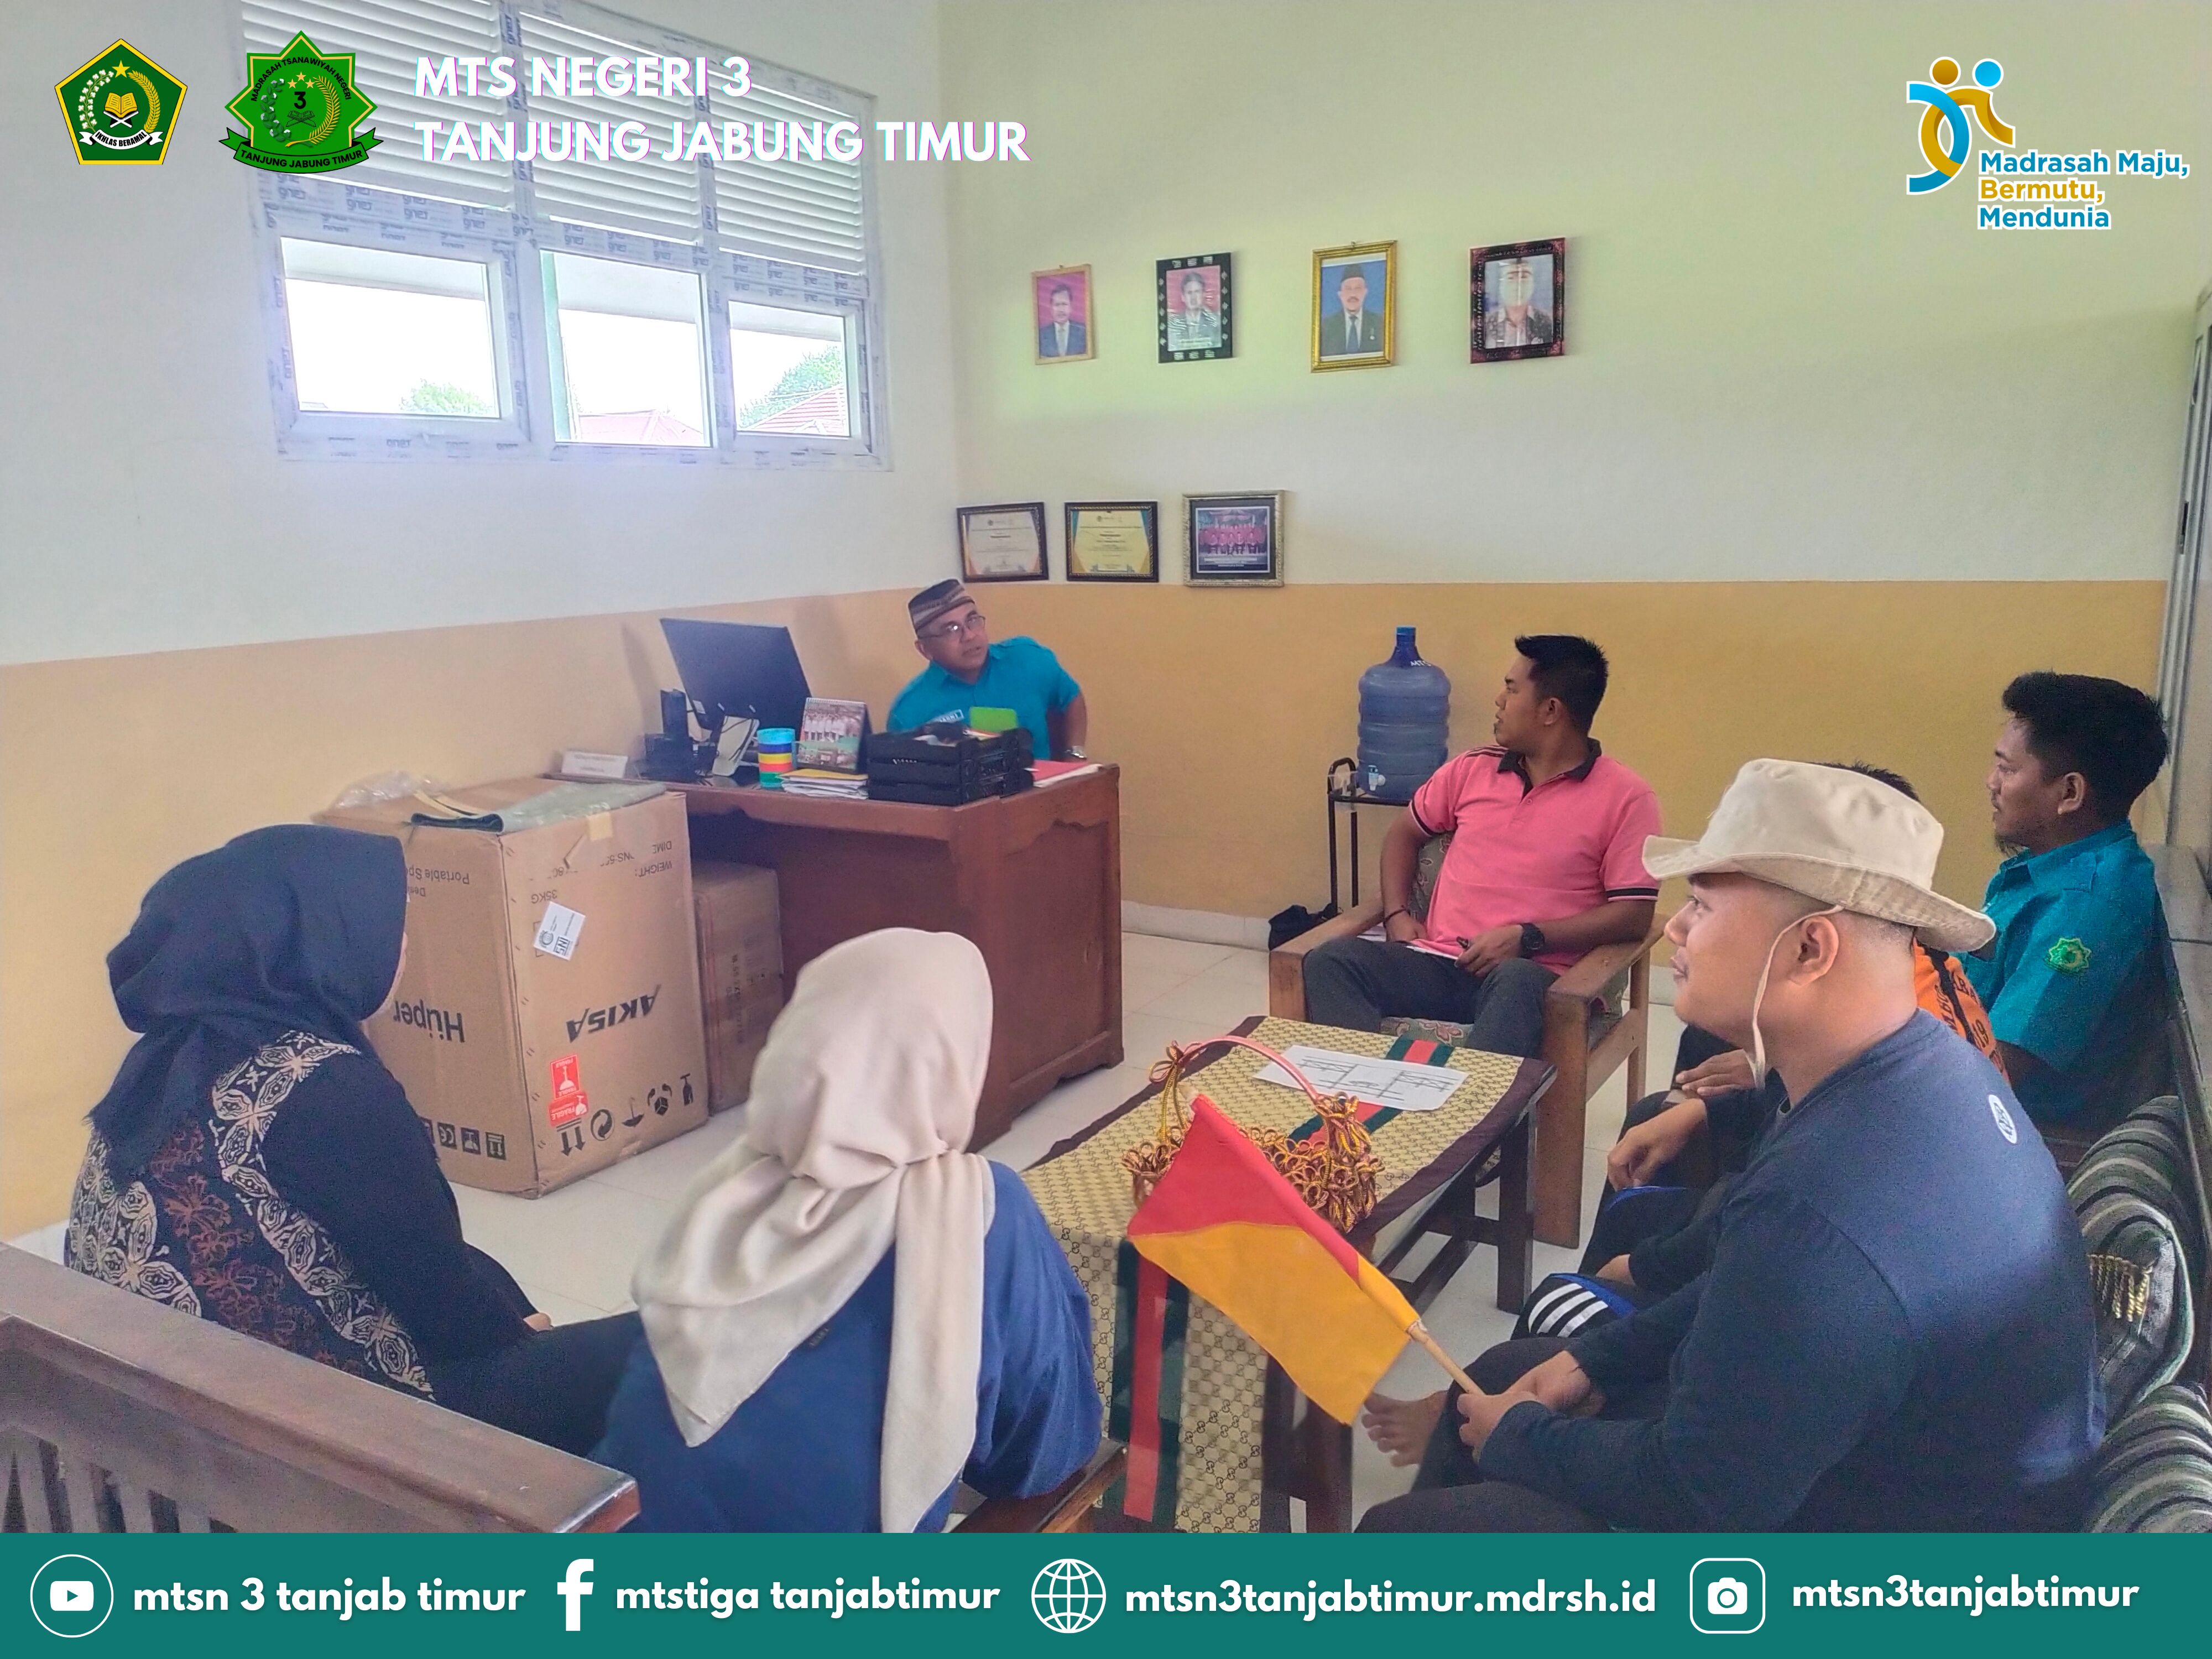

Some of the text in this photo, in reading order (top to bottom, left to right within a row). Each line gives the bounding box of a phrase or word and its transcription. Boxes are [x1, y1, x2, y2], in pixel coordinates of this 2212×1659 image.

[406, 864, 470, 885] Portable Sp
[531, 889, 557, 905] 35KG
[393, 999, 465, 1043] Hüper
[566, 984, 661, 1043] AKISA
[551, 1105, 575, 1120] FRAGILE
